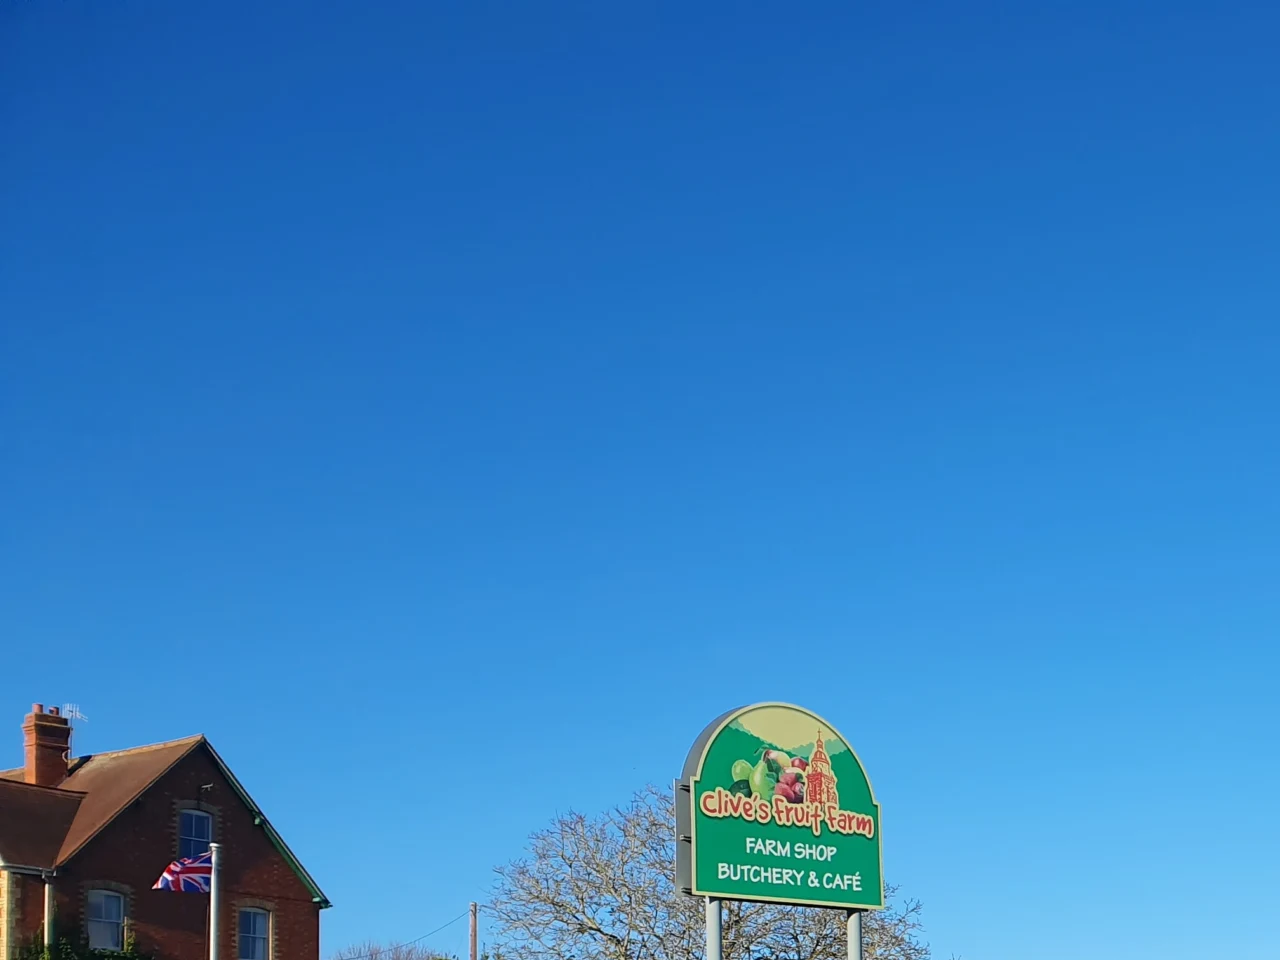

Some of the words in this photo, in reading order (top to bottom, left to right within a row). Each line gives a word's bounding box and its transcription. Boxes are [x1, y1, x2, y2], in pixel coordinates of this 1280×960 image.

[775, 798, 822, 833] fruit
[827, 806, 873, 835] farm
[745, 837, 791, 858] FARM
[794, 843, 837, 861] SHOP
[717, 862, 805, 886] BUTCHERY
[808, 872, 820, 888] &
[822, 871, 863, 891] CAFÉ
